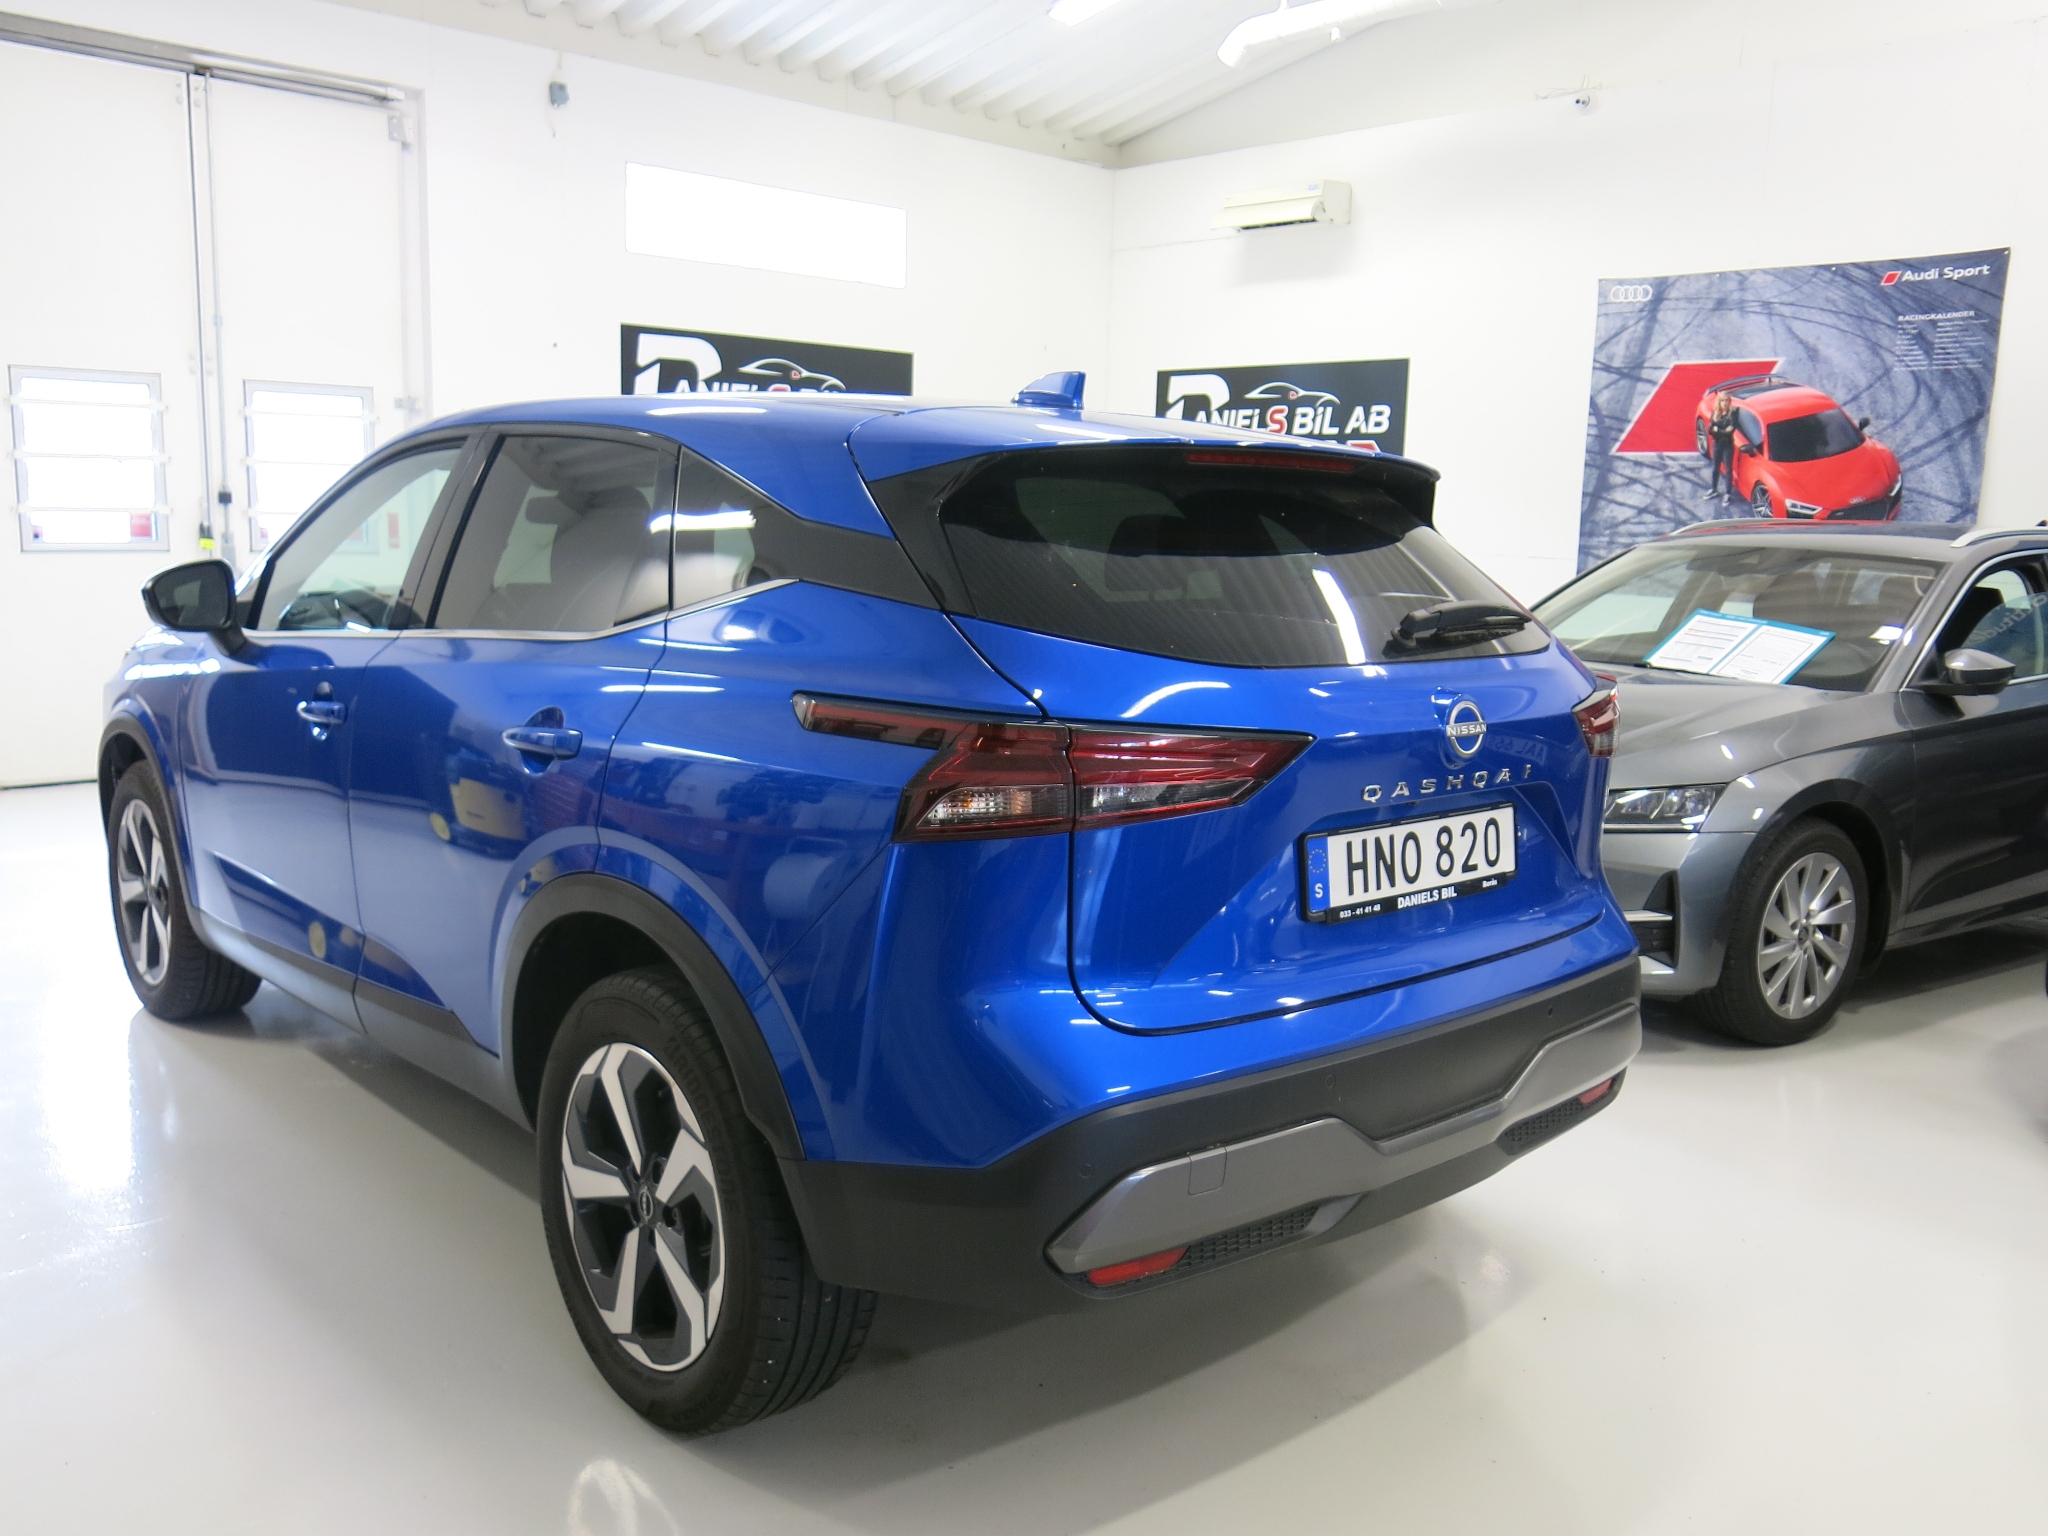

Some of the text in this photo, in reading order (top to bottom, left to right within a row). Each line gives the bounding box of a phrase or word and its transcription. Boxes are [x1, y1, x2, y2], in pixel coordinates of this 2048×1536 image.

[1902, 265, 1990, 281] Audi Sport
[1897, 310, 1975, 321] RACINGKALENDER
[1344, 404, 1391, 434] AB
[1447, 722, 1487, 736] NISSAN
[1362, 764, 1532, 803] QASHQAI
[1346, 817, 1501, 896] HNO 820
[1313, 882, 1324, 899] S
[1397, 885, 1458, 909] DANIELS BIL
[1339, 909, 1352, 918] 033
[1364, 905, 1372, 913] 41
